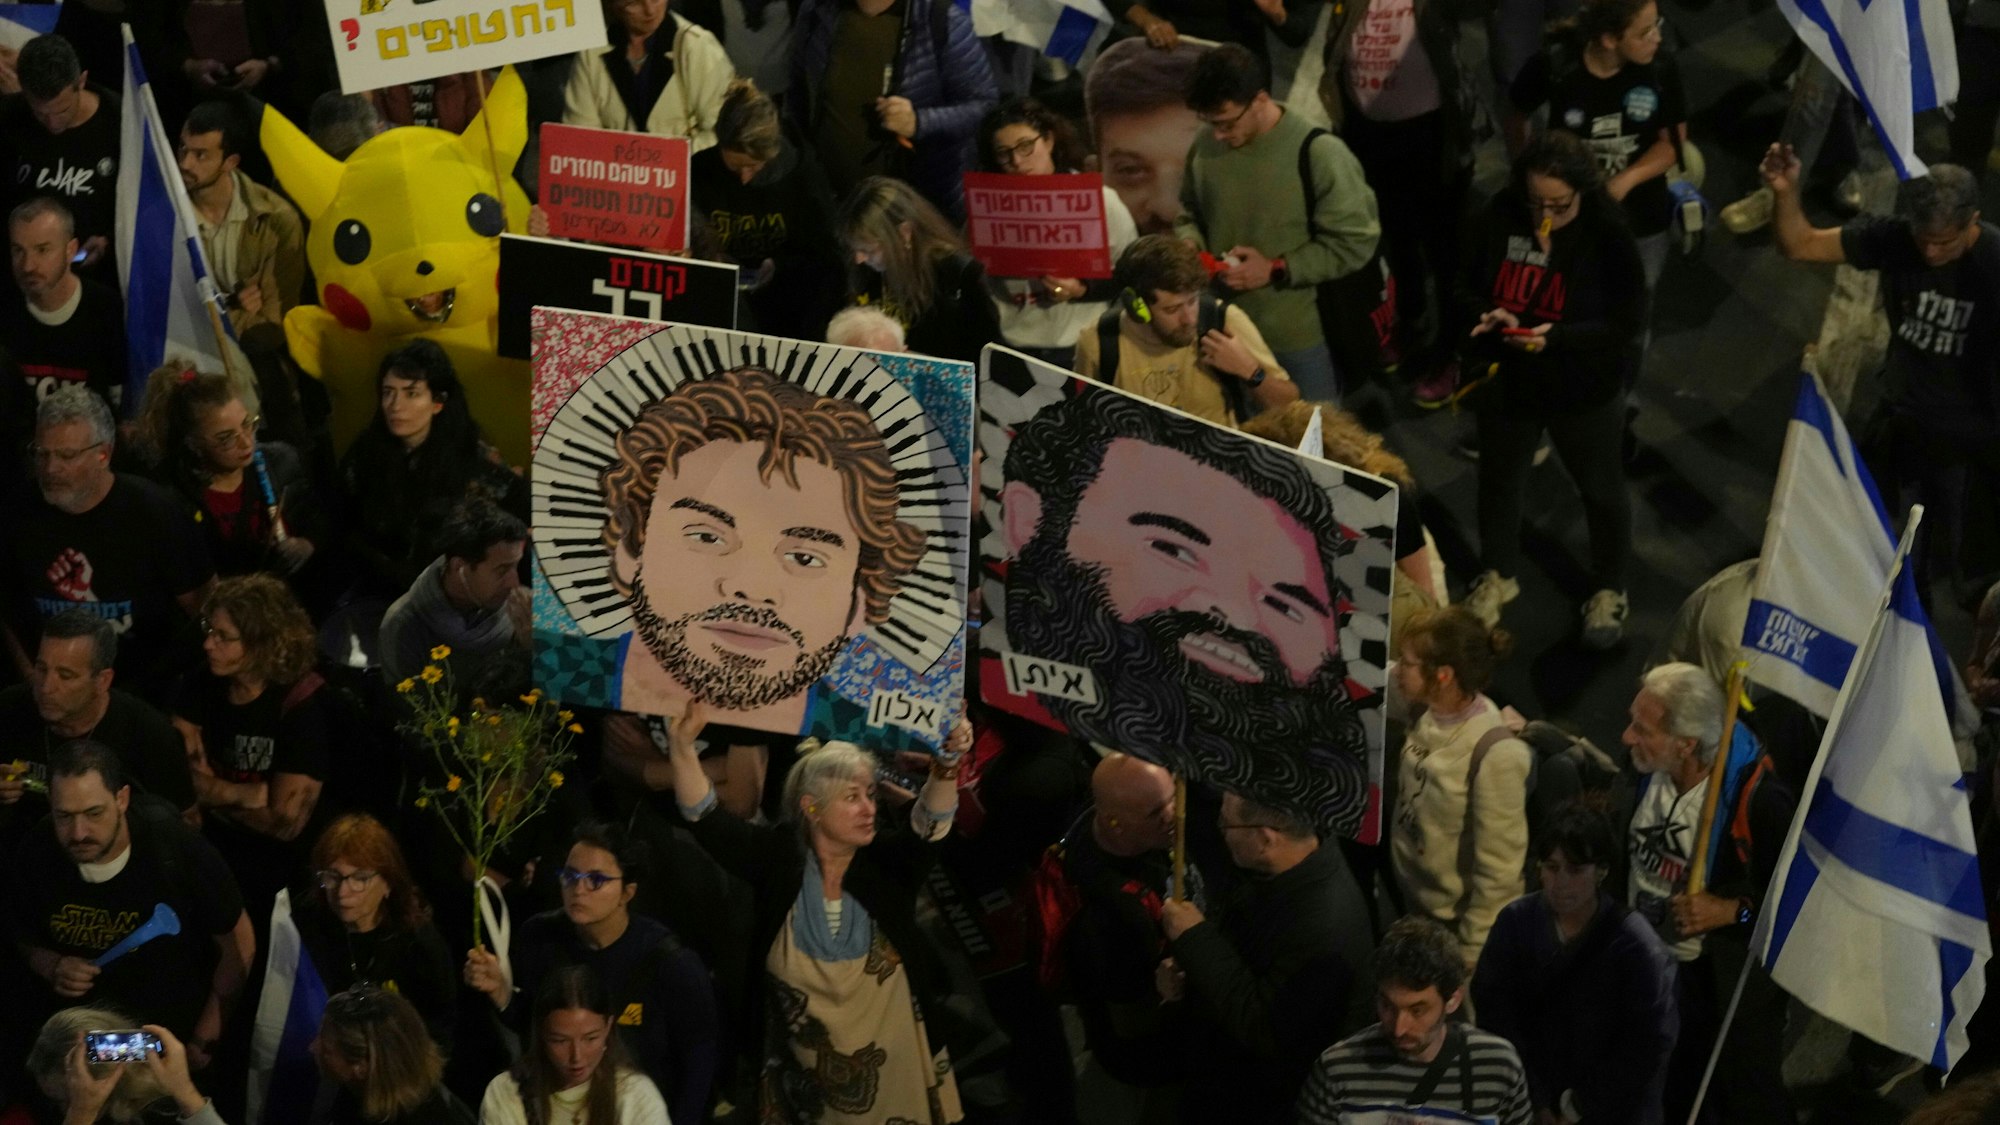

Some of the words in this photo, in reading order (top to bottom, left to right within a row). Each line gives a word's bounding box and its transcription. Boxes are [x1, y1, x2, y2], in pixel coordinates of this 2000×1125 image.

[376, 0, 576, 60] החטופים
[550, 155, 605, 181] חוזרים
[608, 162, 650, 185] שהם
[652, 167, 677, 189] עד
[550, 183, 621, 212] חטופים
[628, 191, 675, 219] כולנו
[975, 192, 1052, 213] החטוף
[1056, 193, 1092, 212] עד
[990, 222, 1083, 245] האחרון
[608, 256, 688, 301] קודם
[1009, 658, 1085, 697] איתן
[874, 694, 935, 728] אלון
